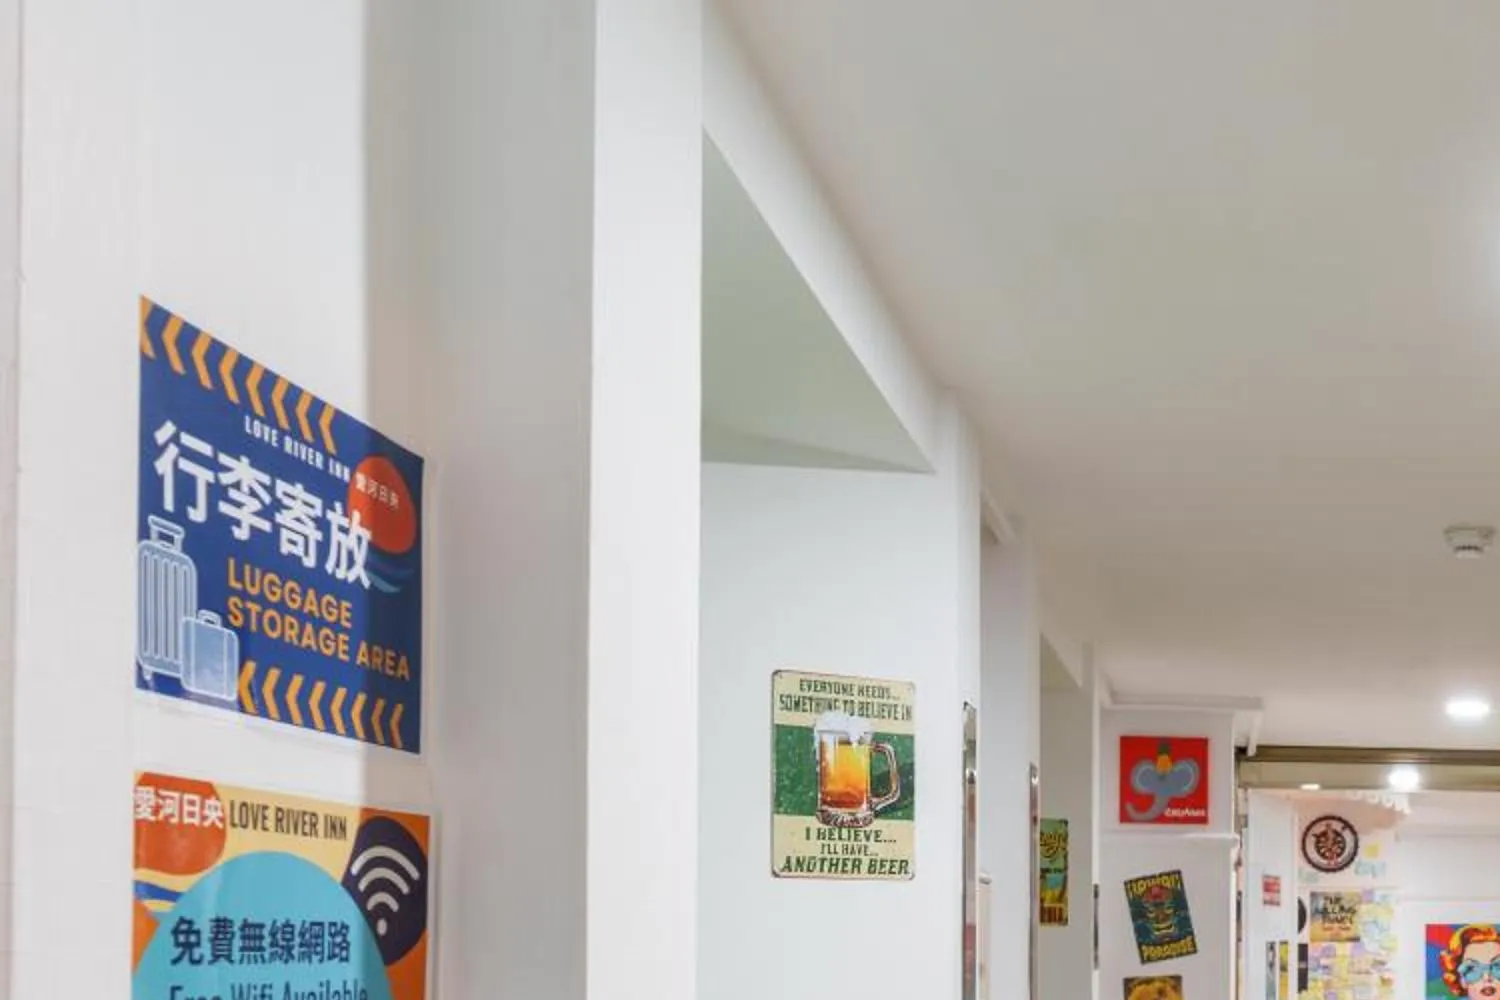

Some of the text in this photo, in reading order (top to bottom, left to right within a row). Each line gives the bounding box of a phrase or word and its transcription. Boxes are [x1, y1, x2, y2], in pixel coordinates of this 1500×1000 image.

[244, 415, 279, 447] LOVE
[284, 434, 324, 469] RIVER
[153, 419, 372, 589] 行李寄放
[228, 557, 353, 629] LUGGAGE
[228, 596, 411, 683] STORAGE AREA
[779, 694, 913, 721] SOMETHING TO BELIEVE IN
[798, 678, 855, 697] EVERYONE
[229, 799, 348, 841] LOVE RIVER INN
[805, 827, 811, 841] I
[781, 855, 863, 875] ANOTHER
[819, 843, 839, 855] I'LL
[169, 916, 352, 967] 免費無線網路
